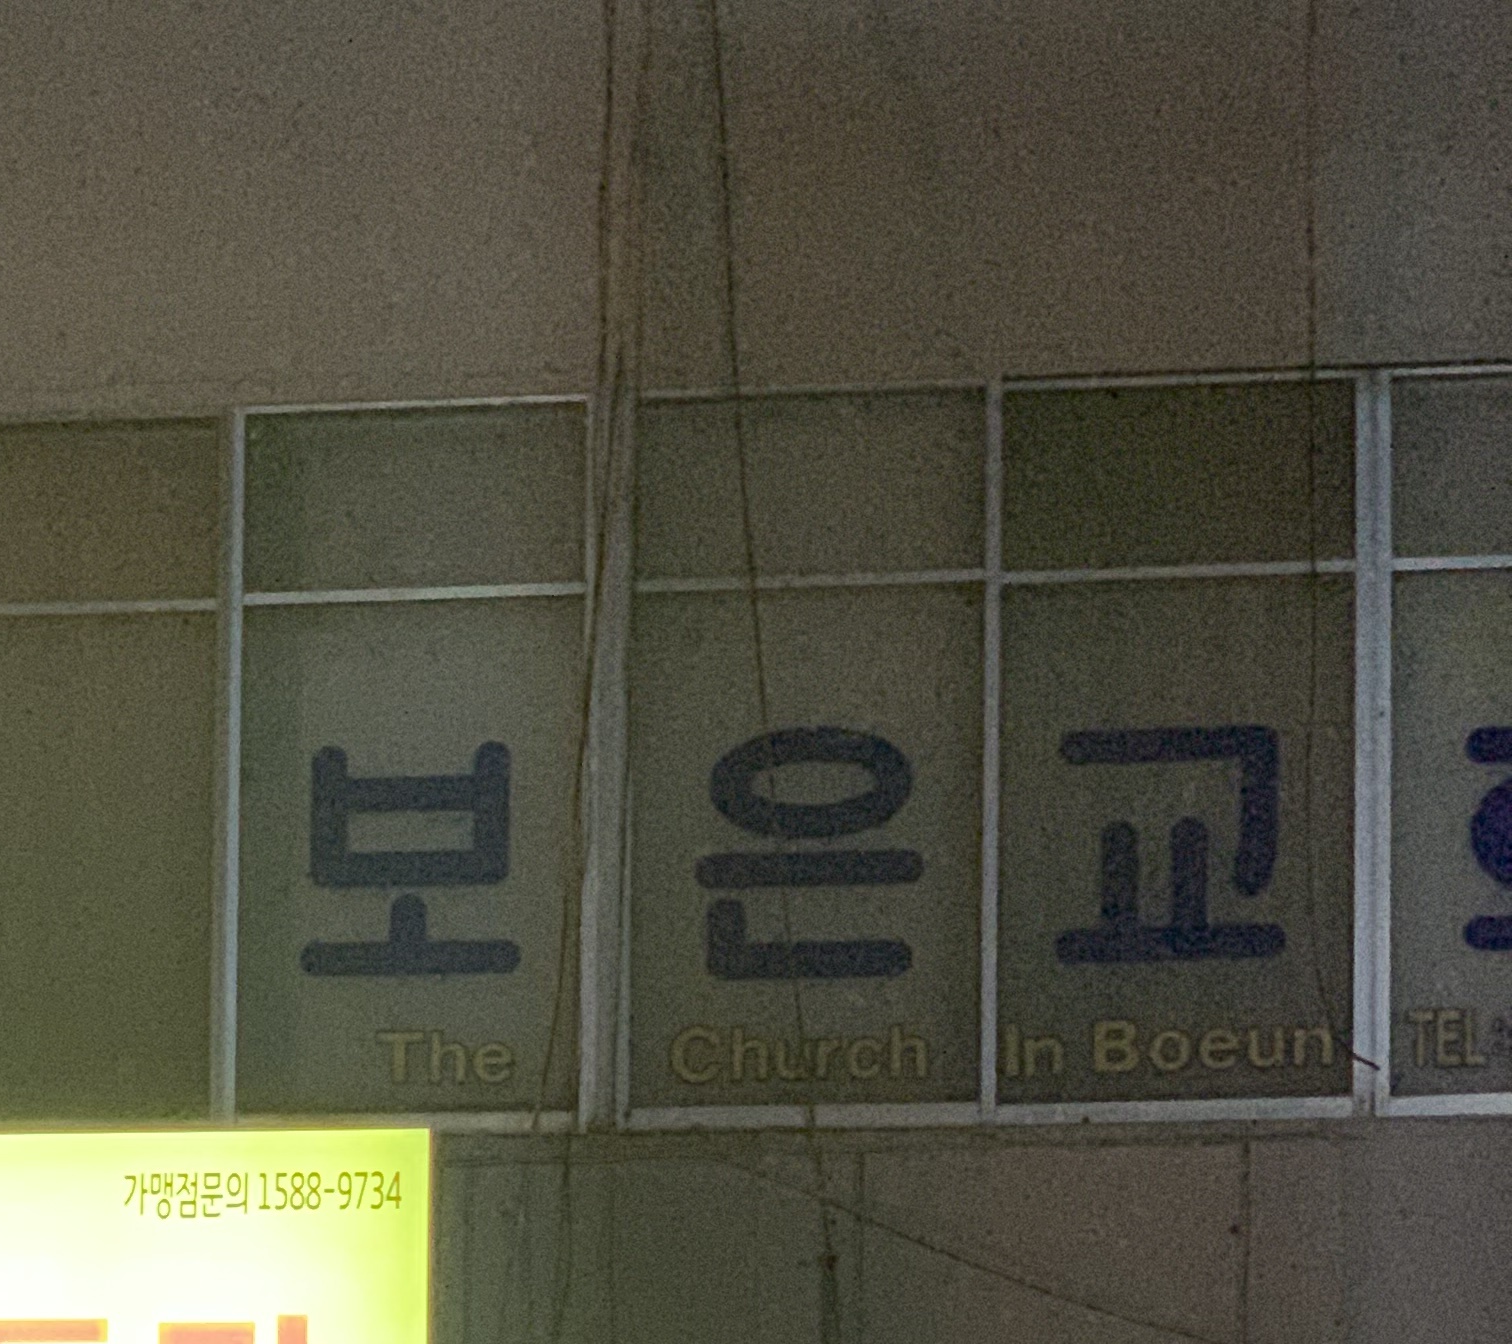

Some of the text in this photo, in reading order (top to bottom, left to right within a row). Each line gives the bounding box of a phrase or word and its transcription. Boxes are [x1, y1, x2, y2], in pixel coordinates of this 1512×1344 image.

[300, 724, 1512, 980] 보은교
[376, 1020, 1333, 1084] The Church In Boeun
[124, 1170, 403, 1220] 가맹점문의 1588-9734
